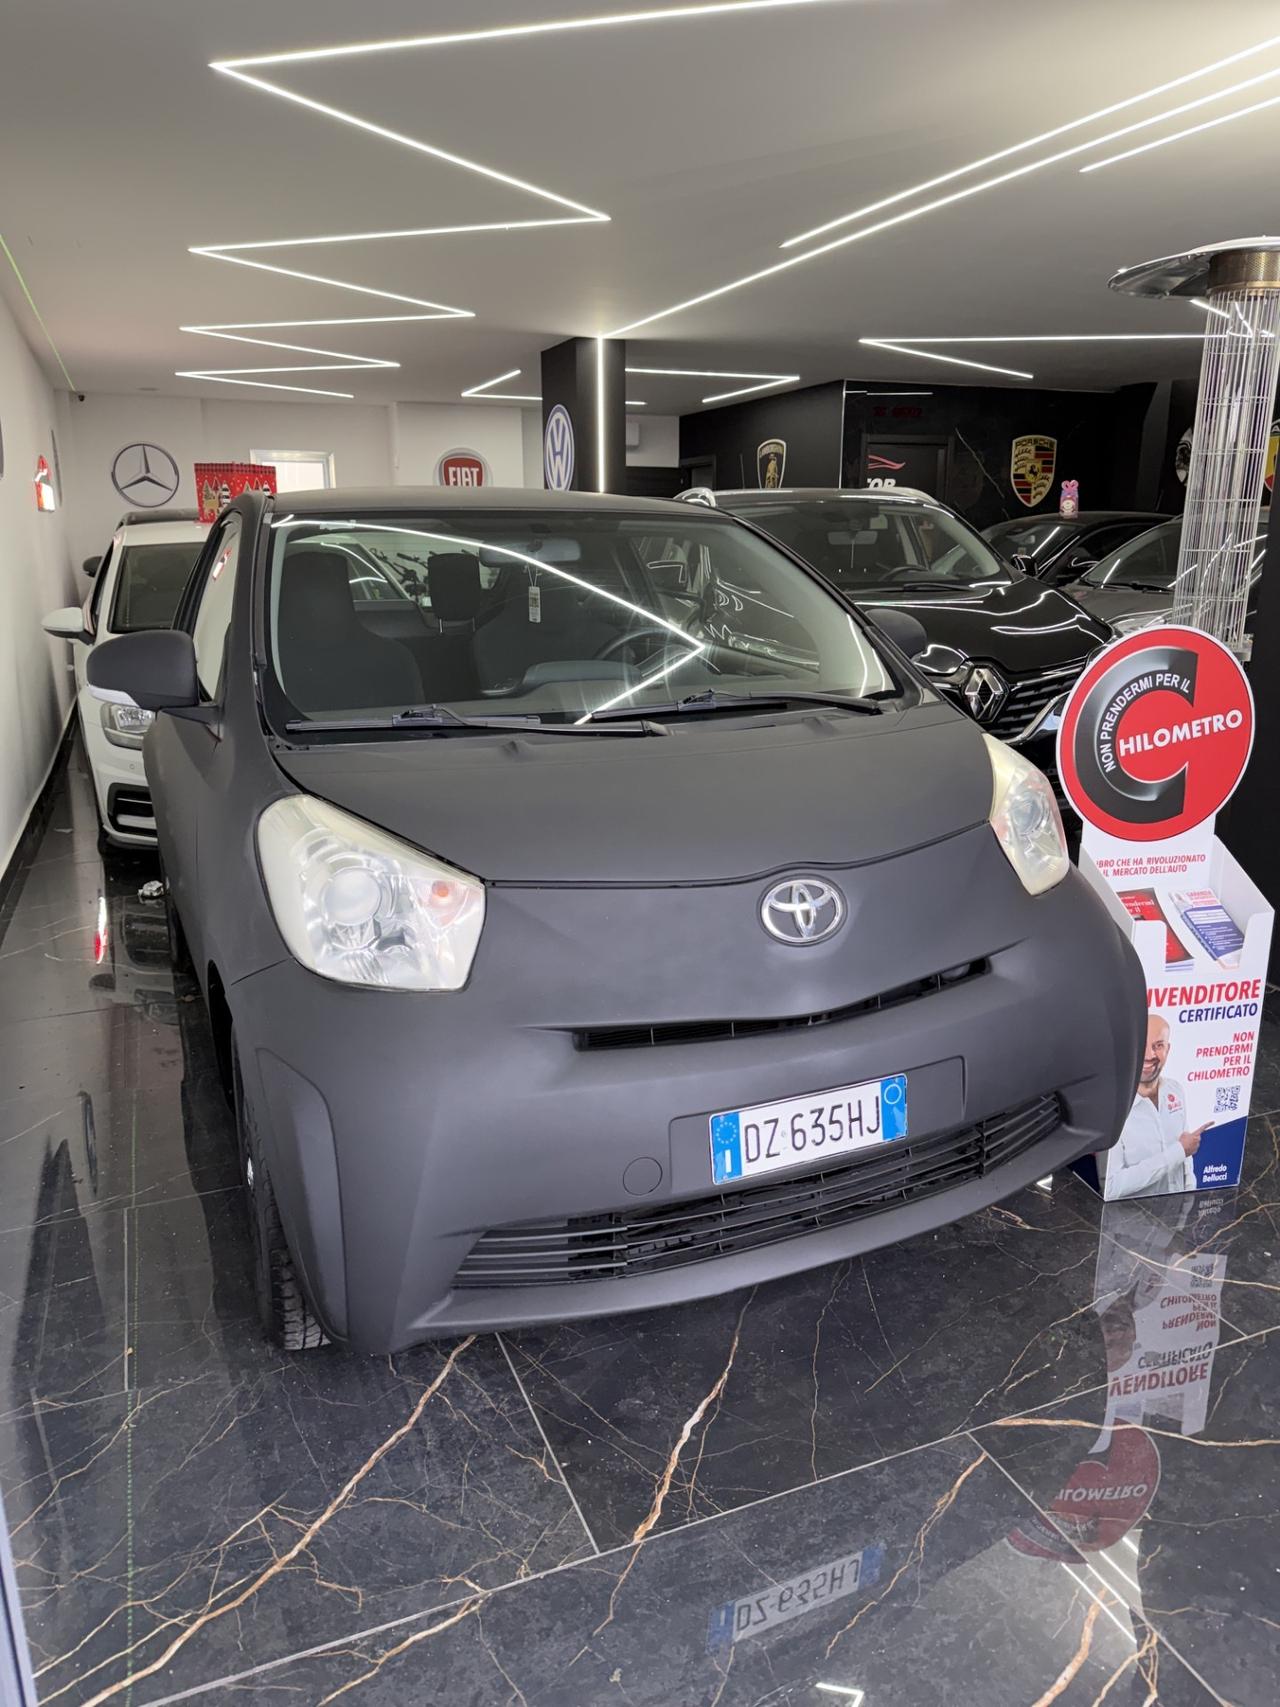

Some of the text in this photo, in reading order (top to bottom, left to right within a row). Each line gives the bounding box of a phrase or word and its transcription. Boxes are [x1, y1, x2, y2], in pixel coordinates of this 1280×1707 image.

[448, 467, 479, 487] FIAT
[1100, 673, 1191, 773] NON PRENDERMI PER IL
[1116, 857, 1130, 867] CHE
[1132, 857, 1143, 866] HA
[1146, 854, 1206, 865] RIVOLUZIONATO
[1112, 867, 1148, 876] MERCATO
[1149, 865, 1187, 874] DELL'AUTO
[1178, 1002, 1258, 1023] CERTIFICATO
[1233, 1031, 1255, 1043] NON
[1195, 1043, 1253, 1057] PRENDERMI
[1223, 1055, 1252, 1067] PER IL
[1187, 1066, 1250, 1082] CHILOMETRO
[1203, 1164, 1228, 1174] Alfredo
[1202, 1173, 1228, 1183] Bellucci
